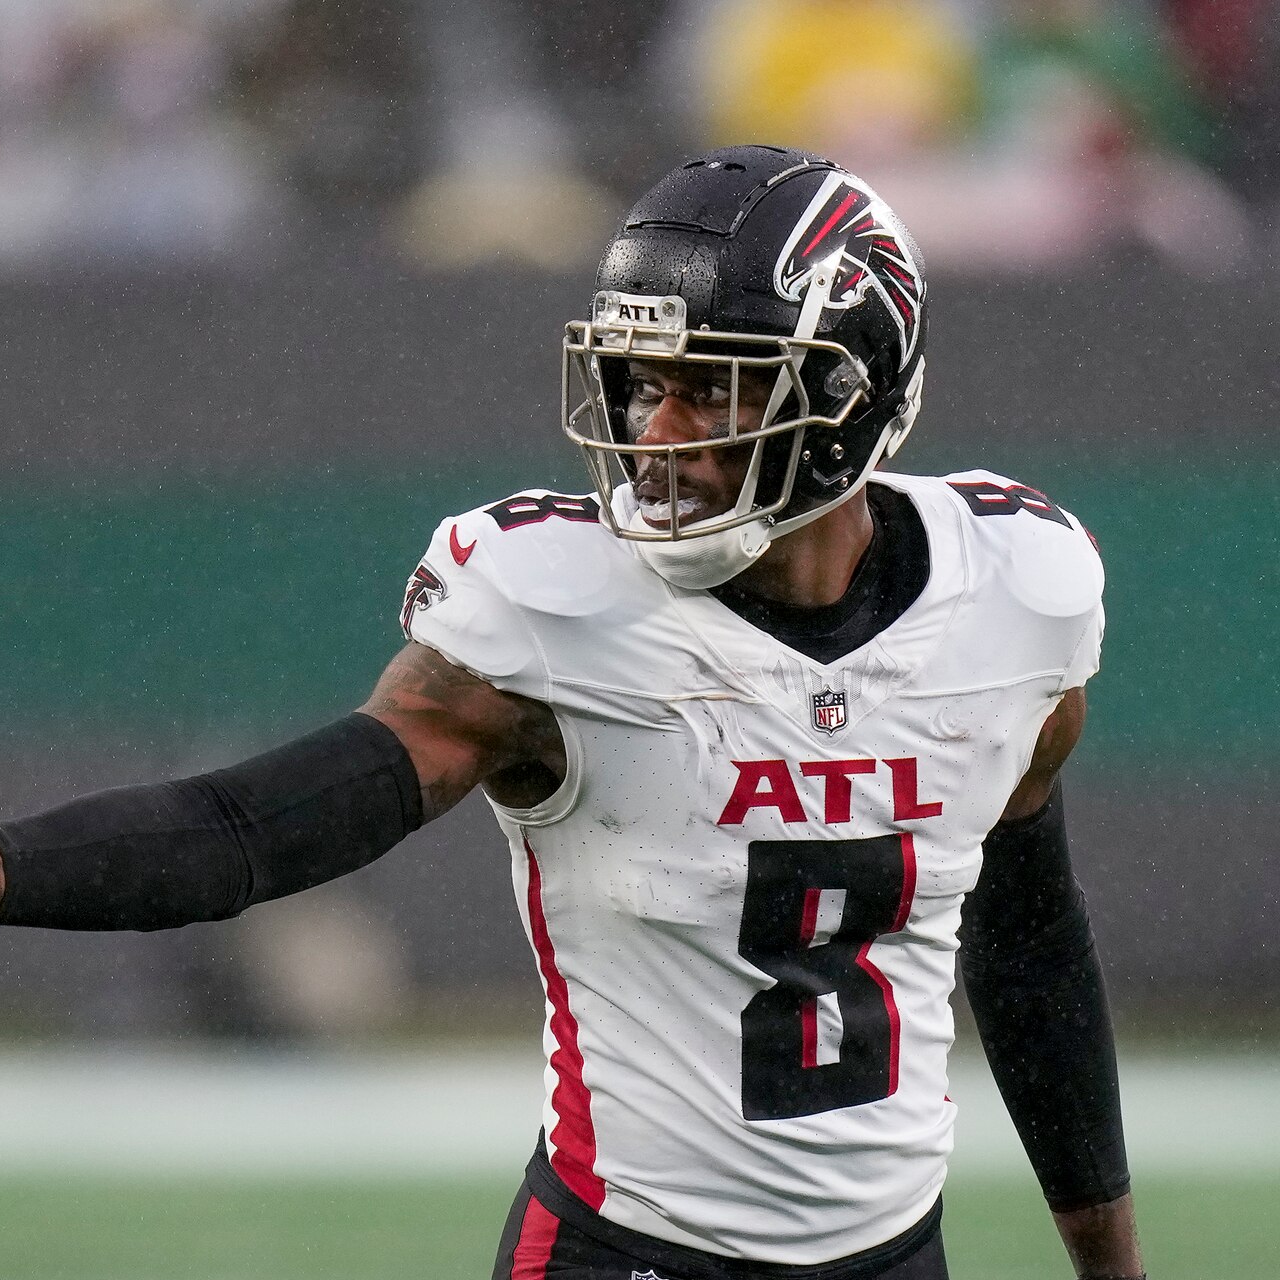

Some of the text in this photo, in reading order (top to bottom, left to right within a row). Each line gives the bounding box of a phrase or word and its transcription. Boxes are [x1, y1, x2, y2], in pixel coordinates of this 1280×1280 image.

[619, 303, 659, 322] ATL
[483, 495, 600, 532] 8
[946, 481, 1075, 531] 8
[816, 707, 844, 728] NFL
[717, 757, 944, 825] ATL
[738, 832, 918, 1122] 8
